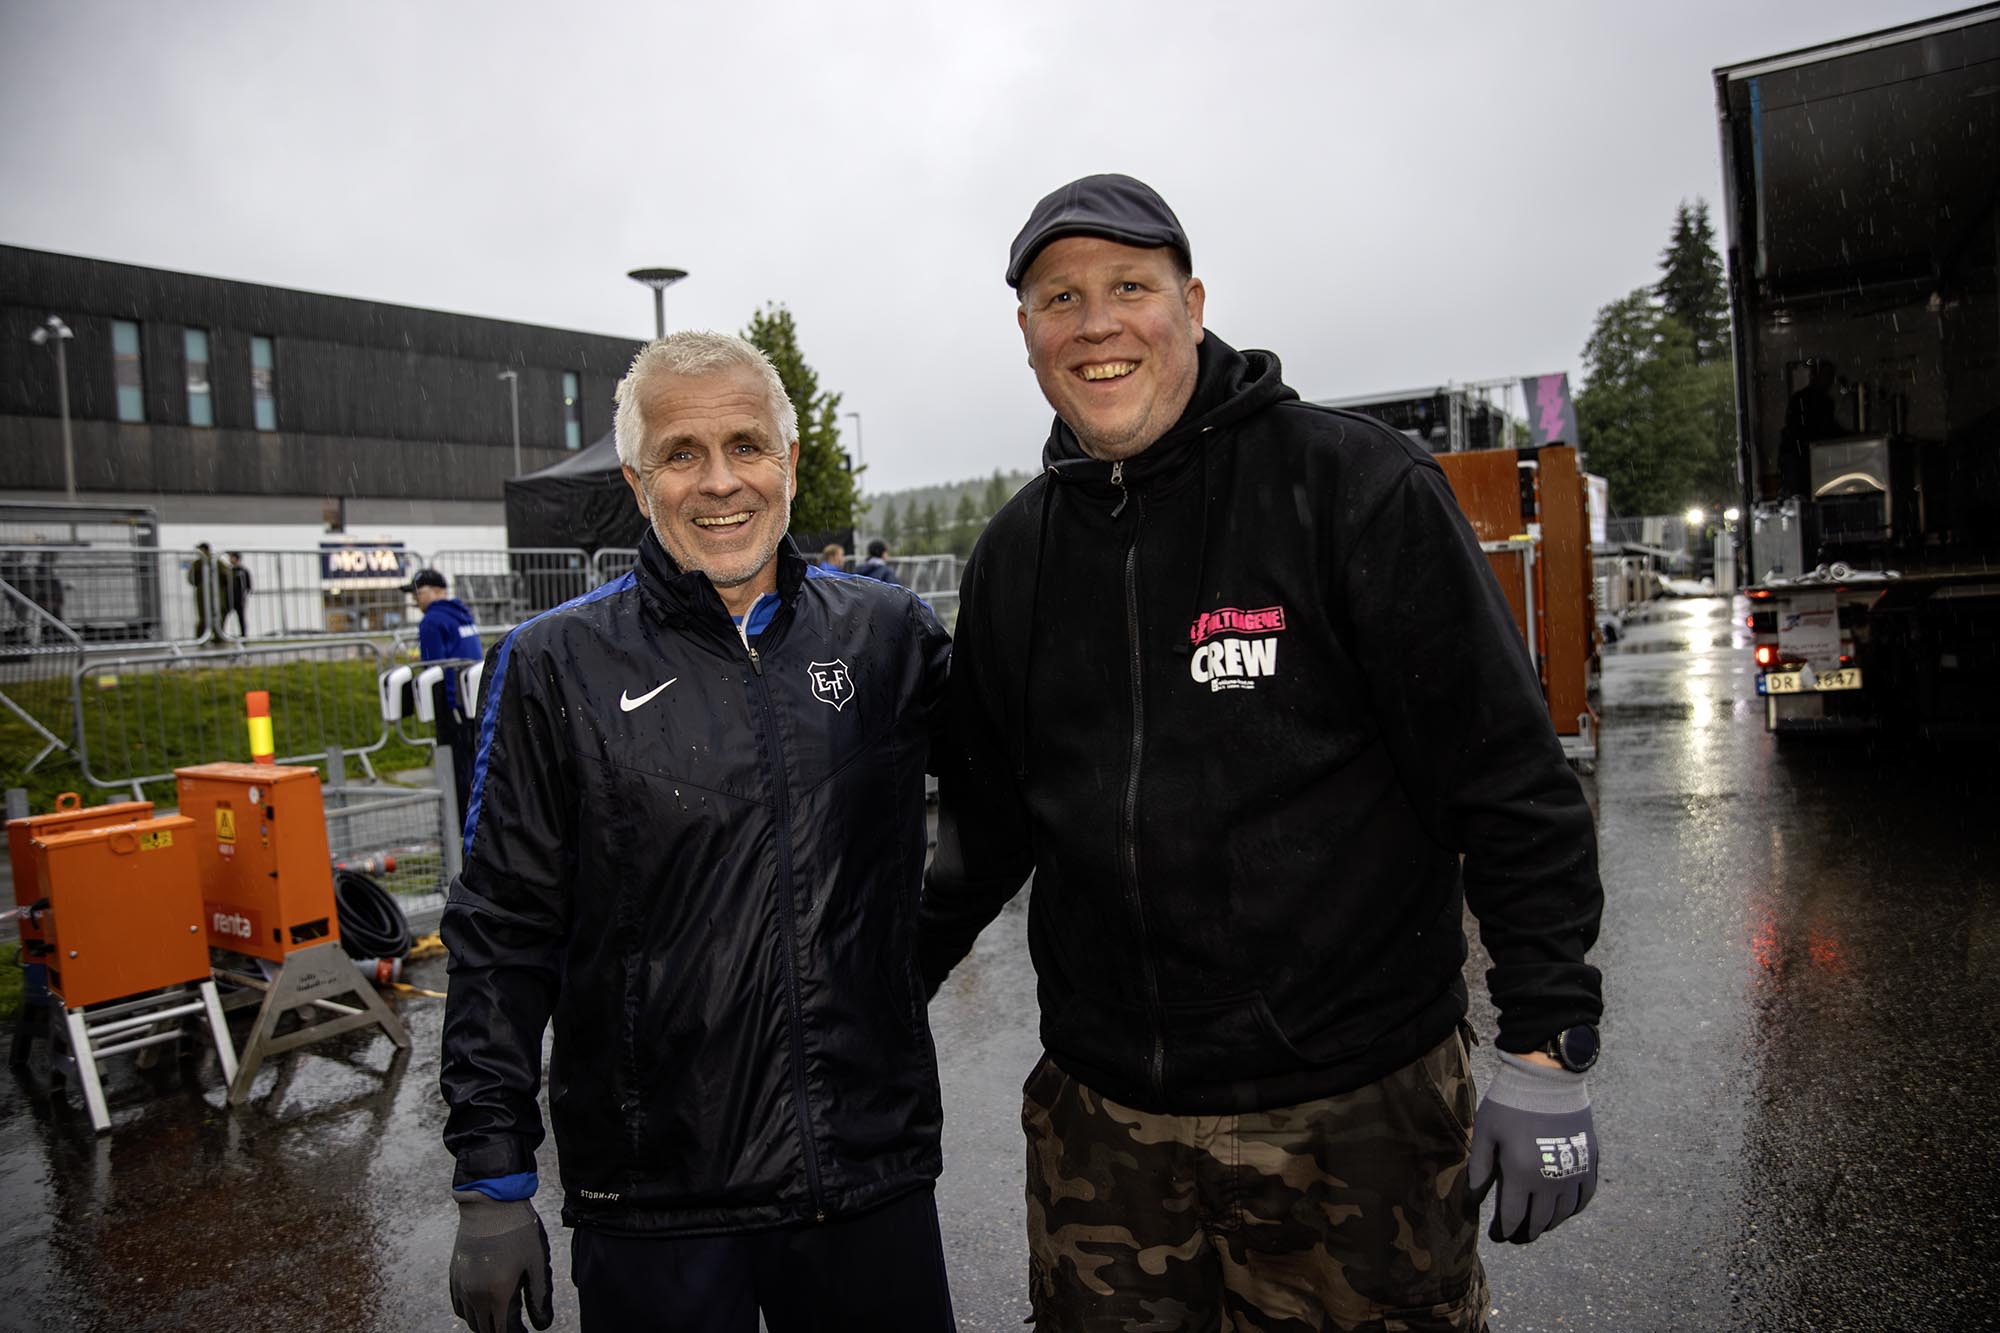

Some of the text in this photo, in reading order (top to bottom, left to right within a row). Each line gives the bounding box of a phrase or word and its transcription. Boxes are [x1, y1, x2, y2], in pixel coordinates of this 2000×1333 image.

[1190, 638, 1278, 683] CREW
[1771, 676, 1793, 690] DR
[213, 911, 252, 938] renta
